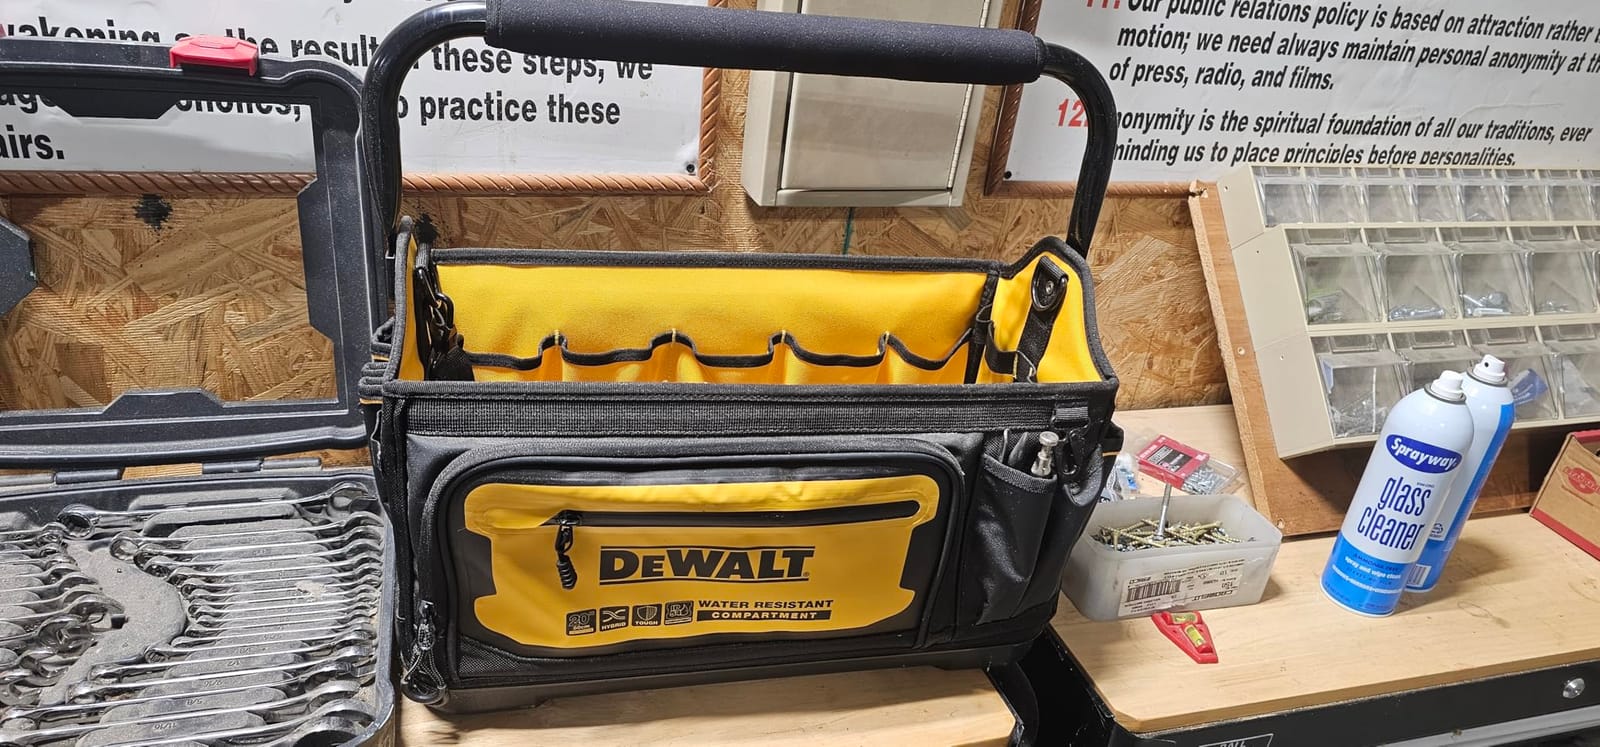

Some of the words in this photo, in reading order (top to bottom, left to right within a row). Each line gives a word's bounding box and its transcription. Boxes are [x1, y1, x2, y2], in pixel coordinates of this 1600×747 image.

[1165, 0, 1226, 19] public
[1230, 0, 1312, 23] relations
[1312, 1, 1369, 32] policy
[1371, 4, 1388, 28] is
[1390, 6, 1444, 33] based
[1444, 16, 1465, 34] on
[1467, 14, 1544, 40] attraction
[1546, 19, 1594, 42] rather
[431, 44, 512, 74] these
[523, 52, 605, 84] steps,
[616, 61, 653, 80] we
[1117, 23, 1191, 55] motion;
[1196, 32, 1223, 52] we
[1227, 31, 1276, 54] need
[1277, 32, 1340, 62] always
[1342, 37, 1416, 63] maintain
[1415, 45, 1489, 68] personal
[1488, 49, 1567, 76] anonymity
[1567, 52, 1587, 72] at
[1109, 57, 1131, 81] of
[1131, 63, 1189, 88] press,
[1195, 62, 1246, 91] radio,
[1251, 65, 1288, 88] and
[1288, 65, 1335, 90] films.
[420, 90, 537, 126] practice
[547, 93, 621, 125] these
[1198, 108, 1216, 132] is
[1220, 110, 1249, 132] the
[1253, 111, 1326, 137] spiritual
[1326, 113, 1411, 136] foundation
[1415, 116, 1435, 137] of
[1433, 117, 1457, 138] all
[1457, 123, 1483, 139] our
[1484, 120, 1555, 144] traditions,
[1560, 126, 1593, 143] ever
[1183, 143, 1205, 163] us
[1210, 141, 1228, 162] to
[1230, 141, 1280, 167] place
[1283, 142, 1364, 164] principles
[1367, 145, 1416, 165] before
[1419, 147, 1516, 167] personalities.
[1391, 437, 1457, 471] Sprayway
[1377, 477, 1431, 517] glass
[1357, 507, 1425, 551] cleaner
[699, 599, 749, 609] WATER
[754, 599, 834, 609] RESISTANT
[712, 610, 818, 620] COMPARTMENT
[601, 622, 627, 631] HYBRID
